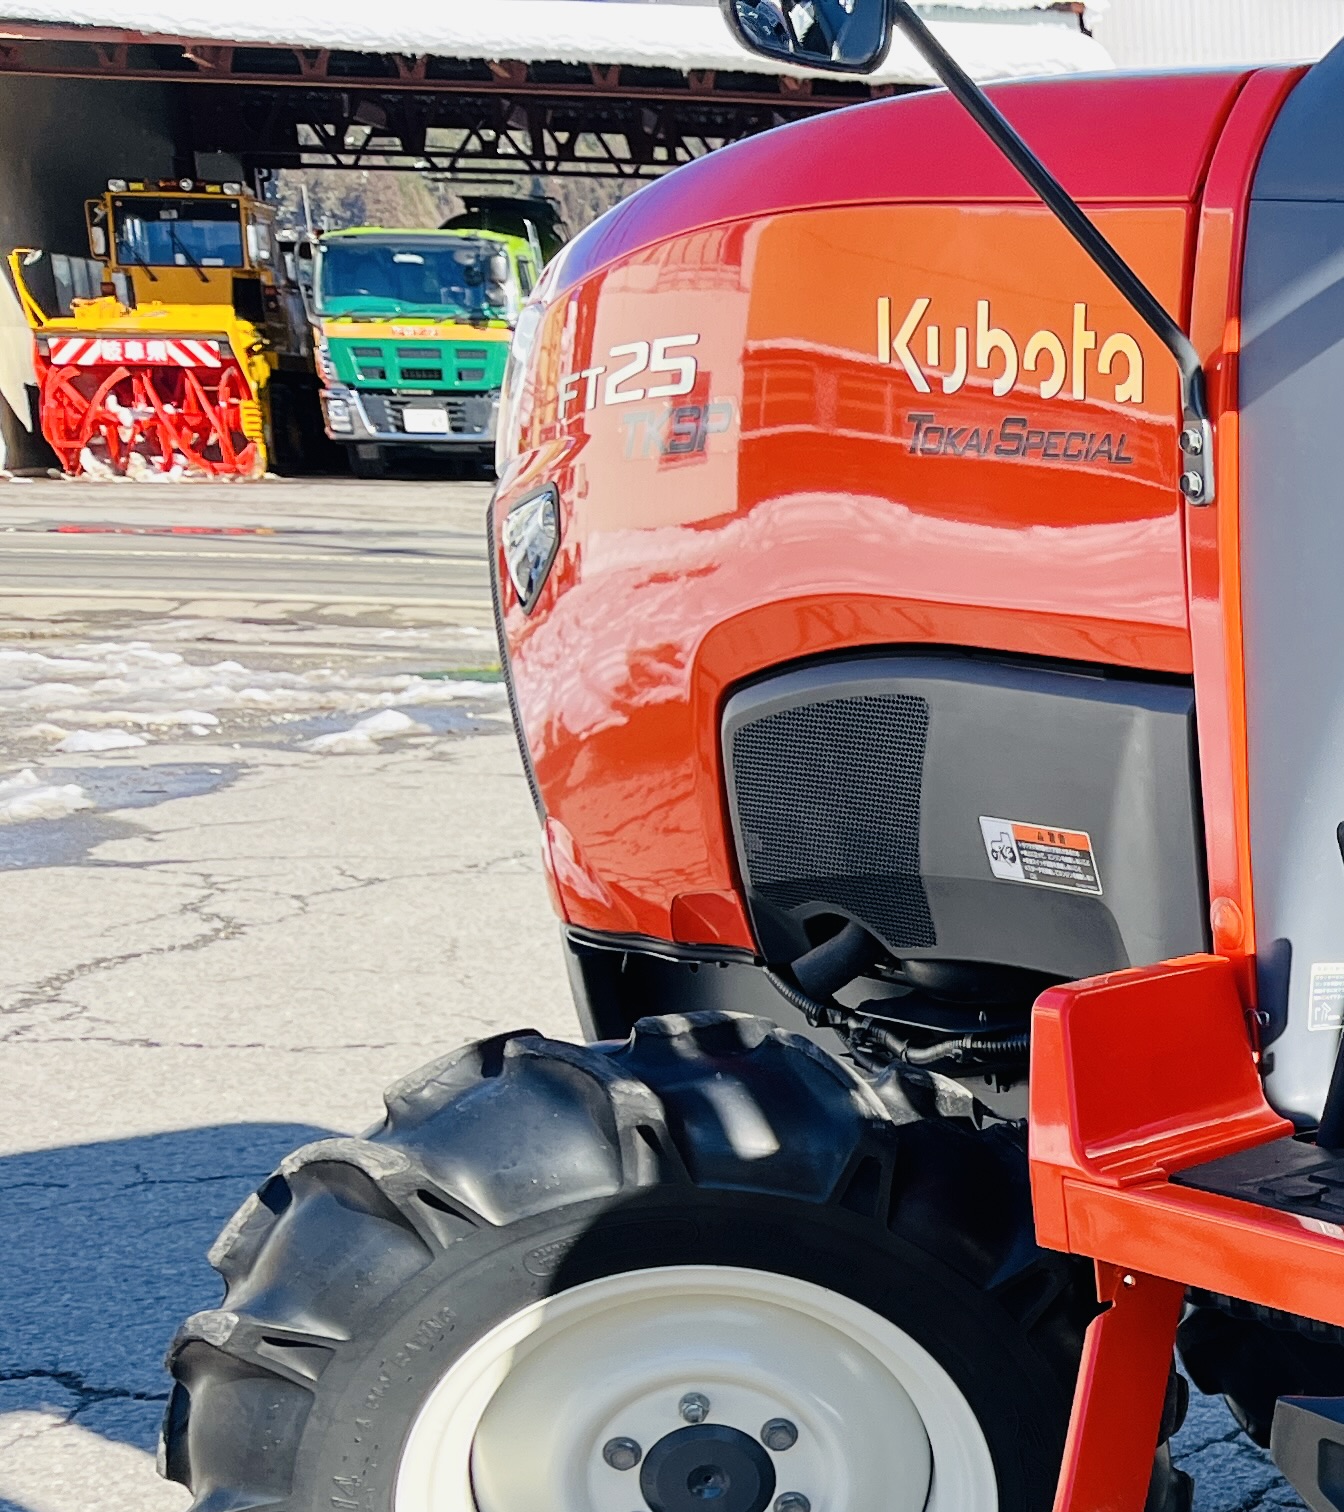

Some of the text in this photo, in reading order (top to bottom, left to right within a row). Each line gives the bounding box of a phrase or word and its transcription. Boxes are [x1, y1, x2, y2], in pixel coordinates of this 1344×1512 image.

[876, 296, 1144, 404] Kubota
[623, 402, 733, 462] TKSP
[994, 416, 1134, 465] SPECIAL
